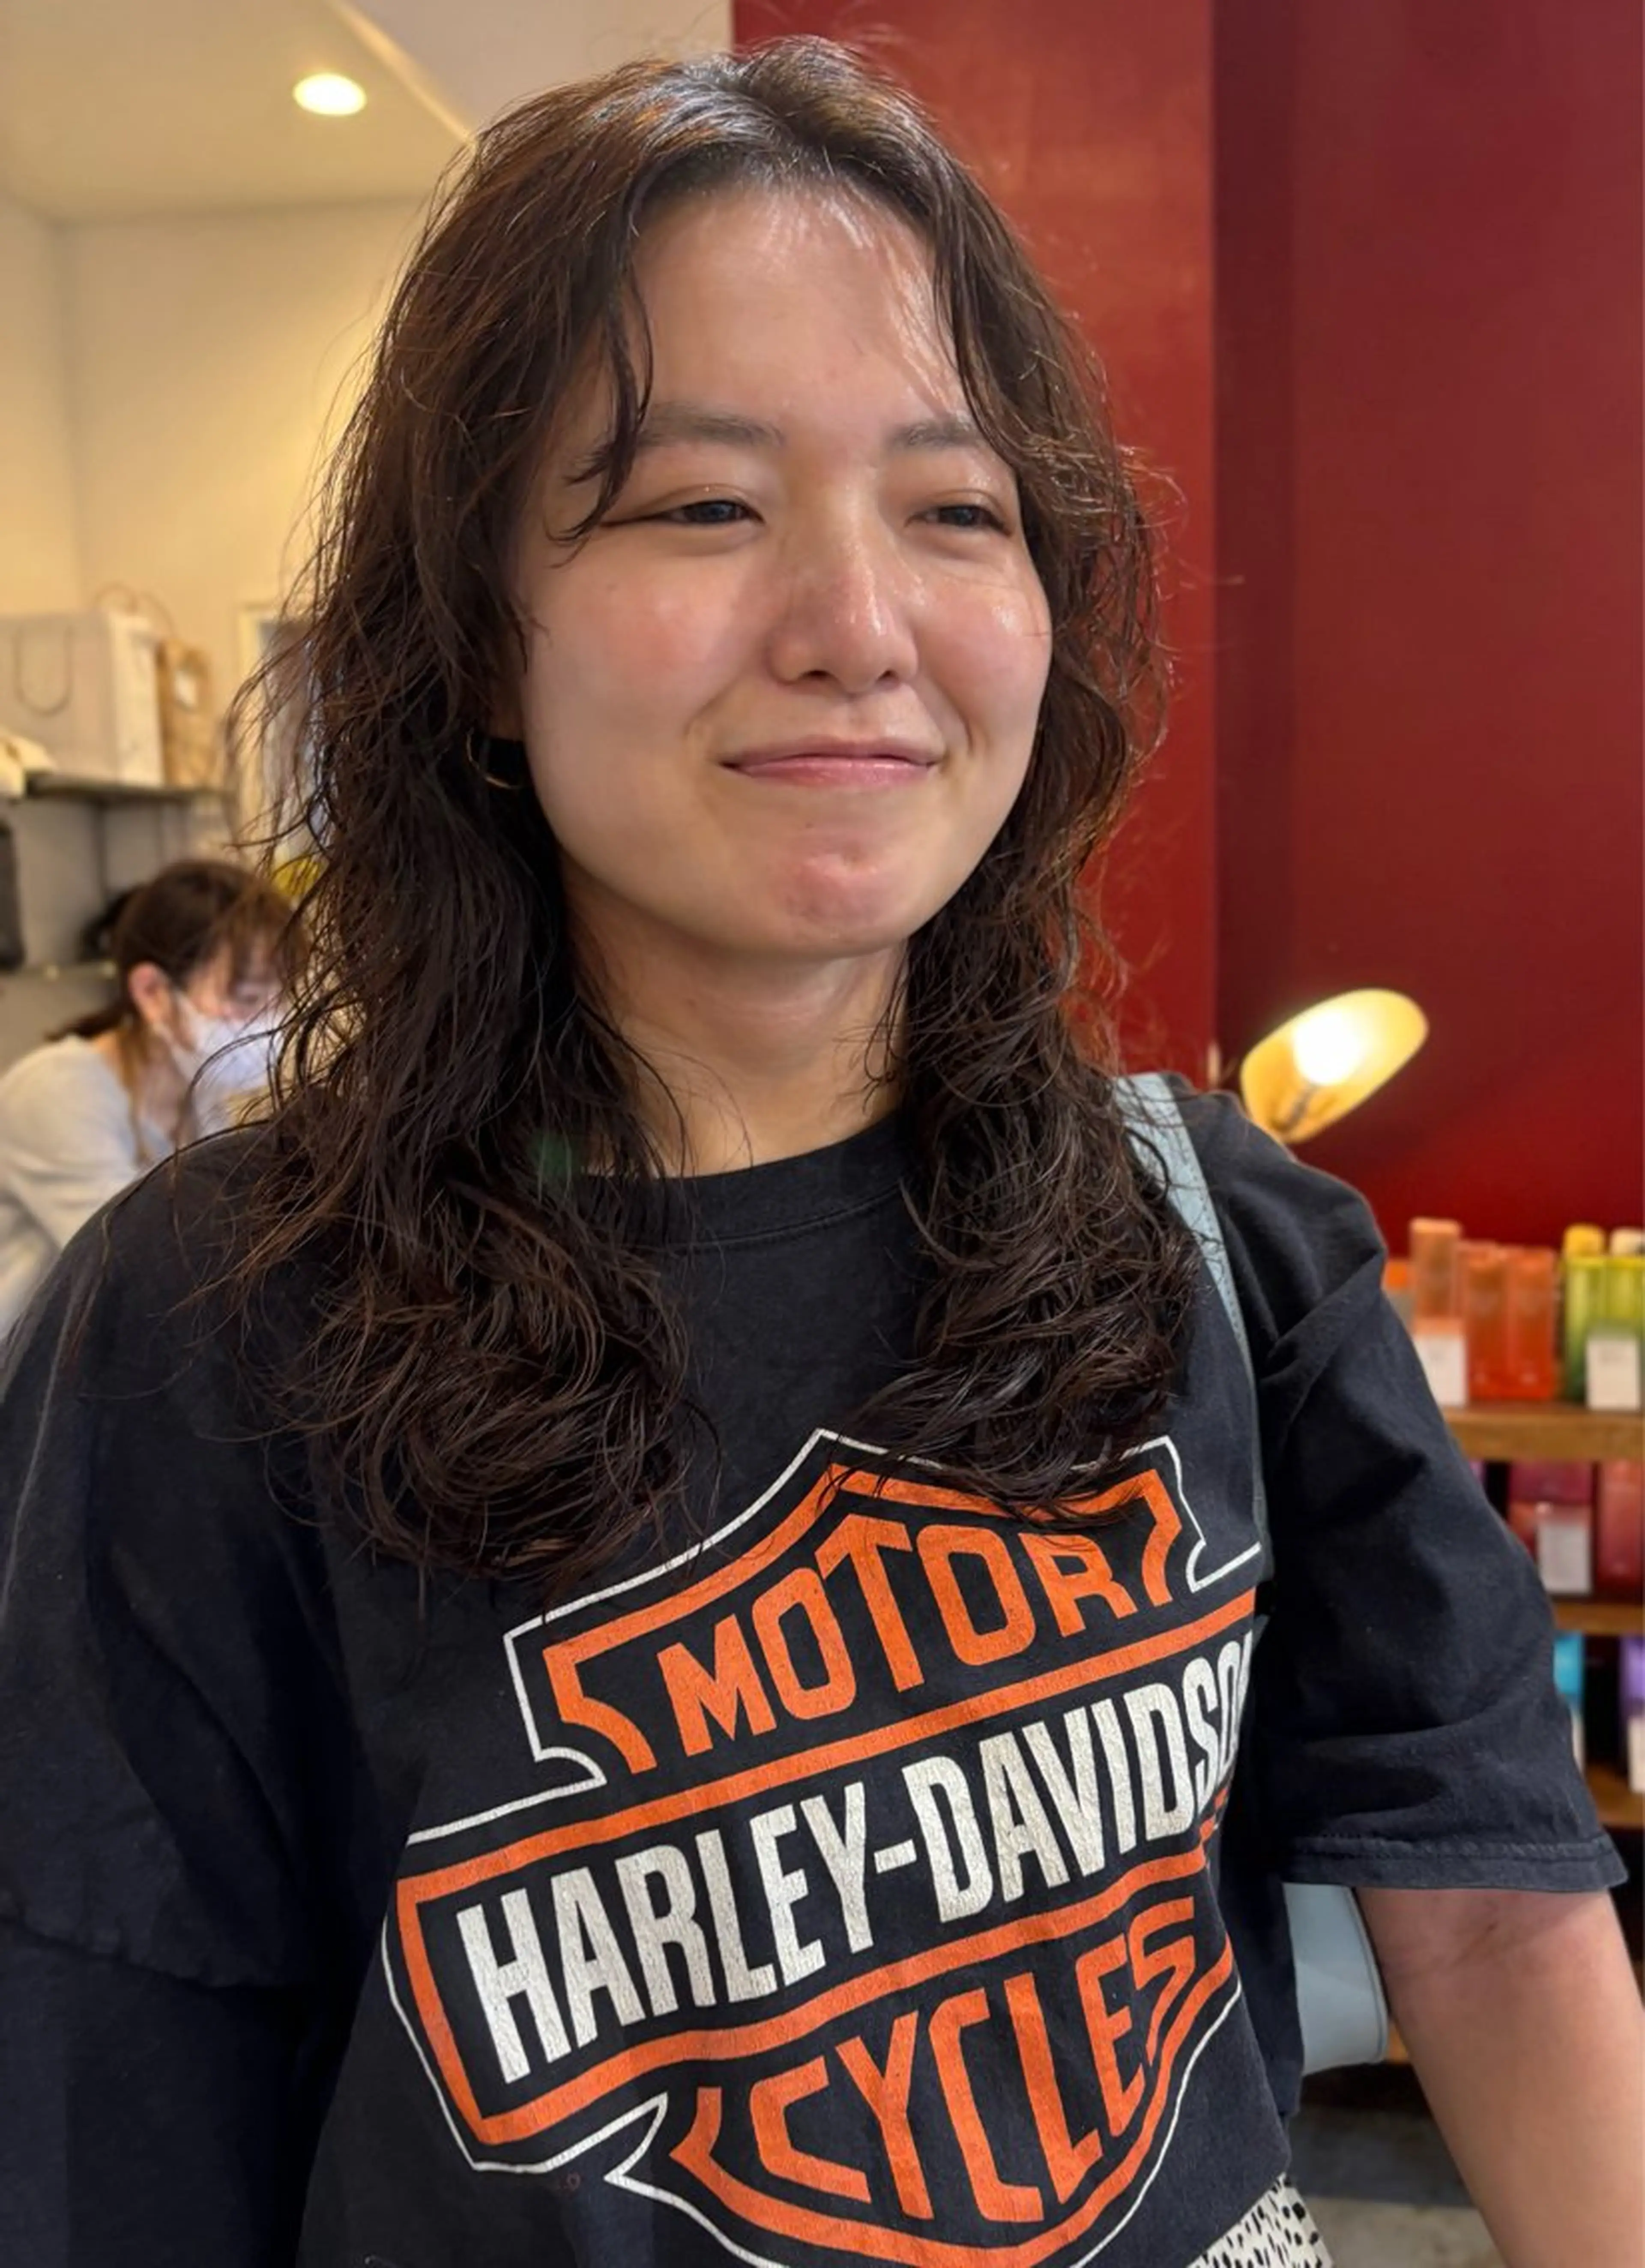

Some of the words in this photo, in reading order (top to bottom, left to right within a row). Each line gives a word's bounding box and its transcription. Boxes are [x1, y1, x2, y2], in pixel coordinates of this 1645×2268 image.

[657, 1514, 1138, 1756] MOTOR
[457, 1629, 1252, 2084] HARLEY-DAVIDSO
[750, 1896, 1195, 2223] CYCLES
